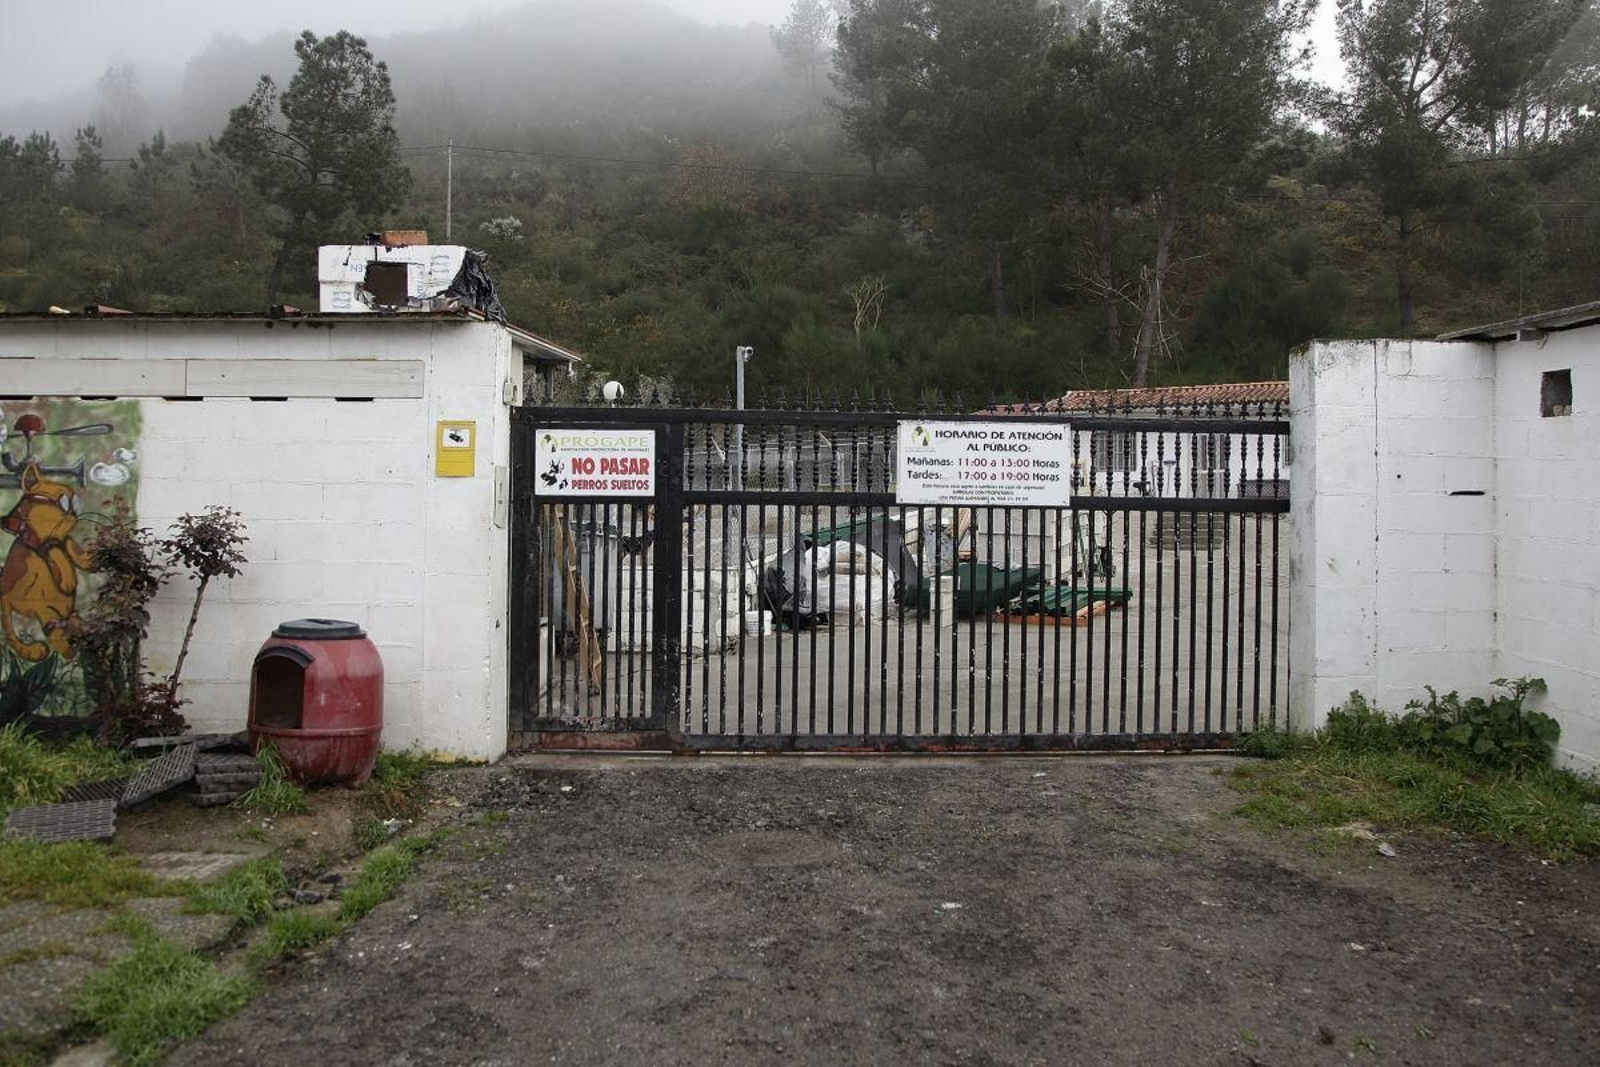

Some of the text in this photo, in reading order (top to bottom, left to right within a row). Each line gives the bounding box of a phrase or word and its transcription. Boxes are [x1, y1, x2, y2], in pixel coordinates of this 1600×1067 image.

[935, 429, 1063, 441] HORARIO DE ATENCIÓN
[560, 436, 649, 448] PROGAPE
[967, 441, 1031, 453] AL PÚBLICO:
[571, 457, 650, 475] NO PASAR
[907, 457, 954, 467] Mañanas:
[958, 458, 987, 467] 11:00
[1032, 459, 1060, 468] Horas
[907, 470, 1060, 481] Tardes: 17:00 a 19:00 Horas
[571, 479, 650, 490] PERROS SUELTOS
